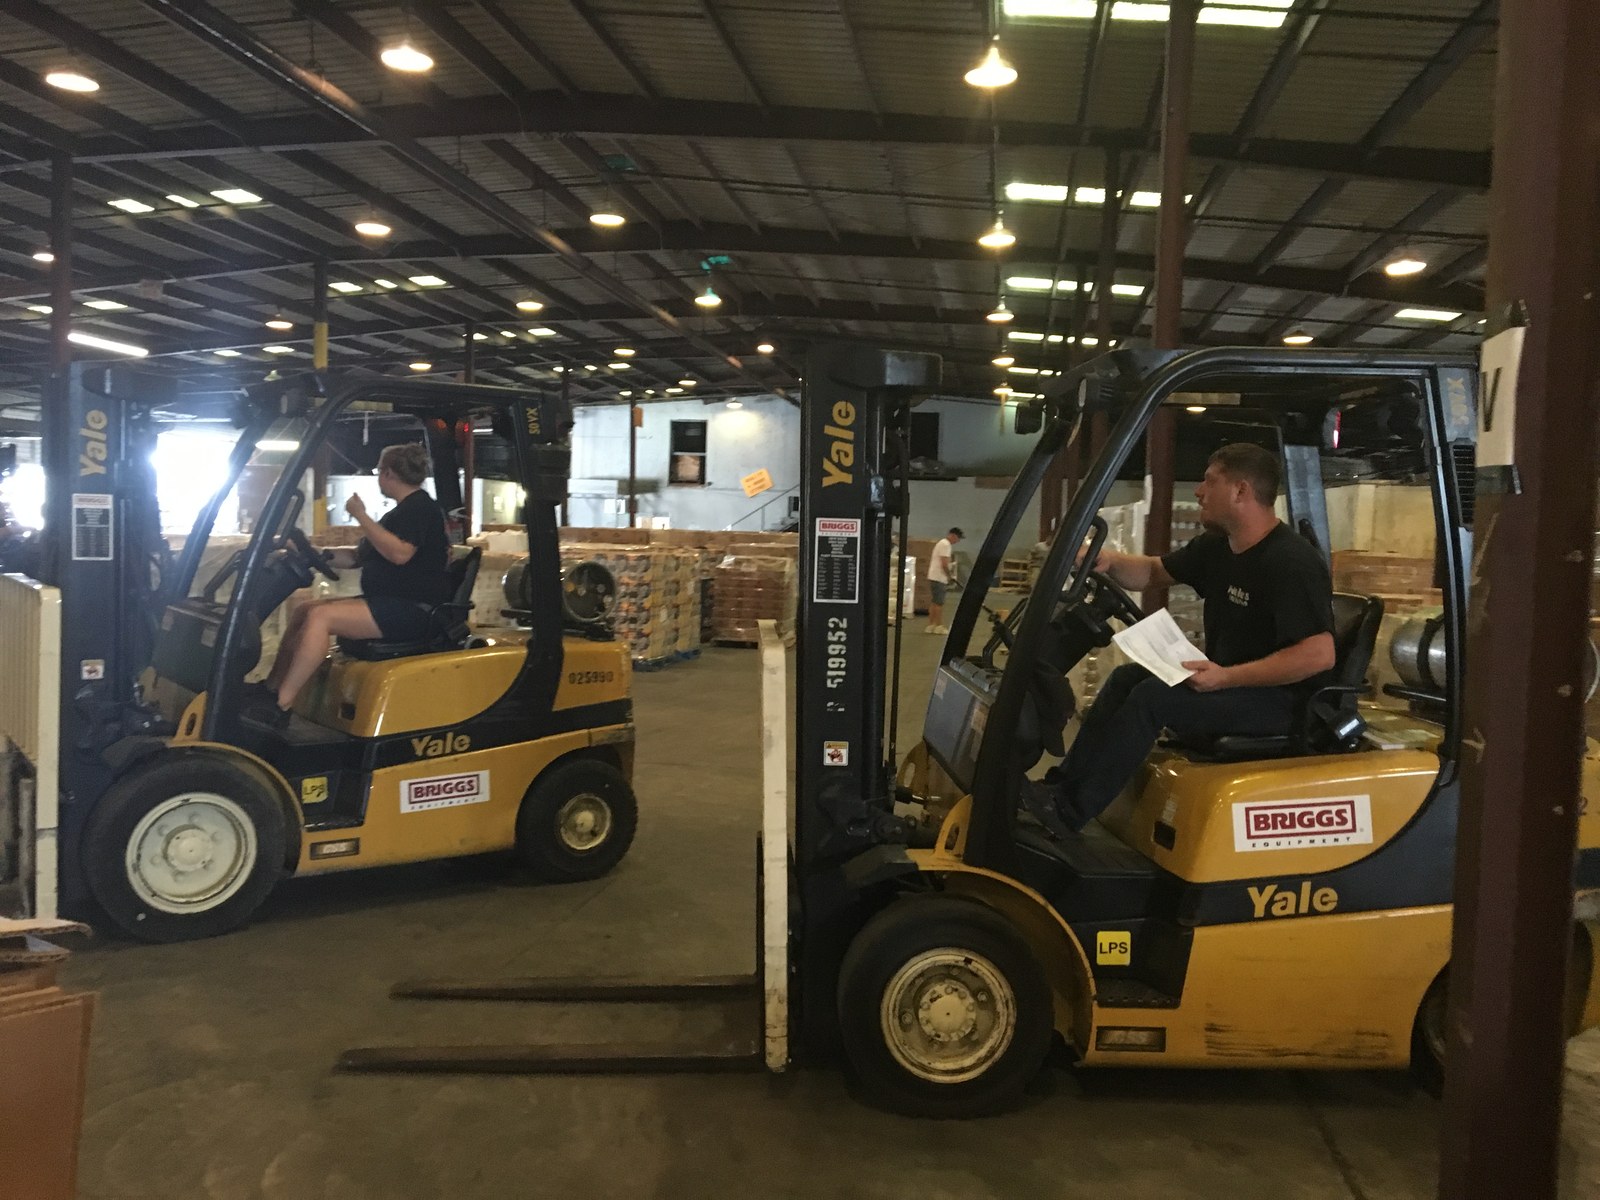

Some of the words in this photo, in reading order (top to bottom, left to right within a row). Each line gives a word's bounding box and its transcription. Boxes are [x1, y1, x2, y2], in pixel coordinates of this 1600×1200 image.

[79, 409, 108, 477] Yale
[822, 400, 856, 488] Yale
[821, 522, 855, 530] BRIGGS
[410, 731, 471, 757] Yale
[414, 779, 475, 799] BRIGGS
[1253, 808, 1349, 832] BRIGGS
[1252, 836, 1351, 848] EQUIPMENT
[1247, 880, 1339, 918] Yale
[1099, 942, 1128, 954] LPS
